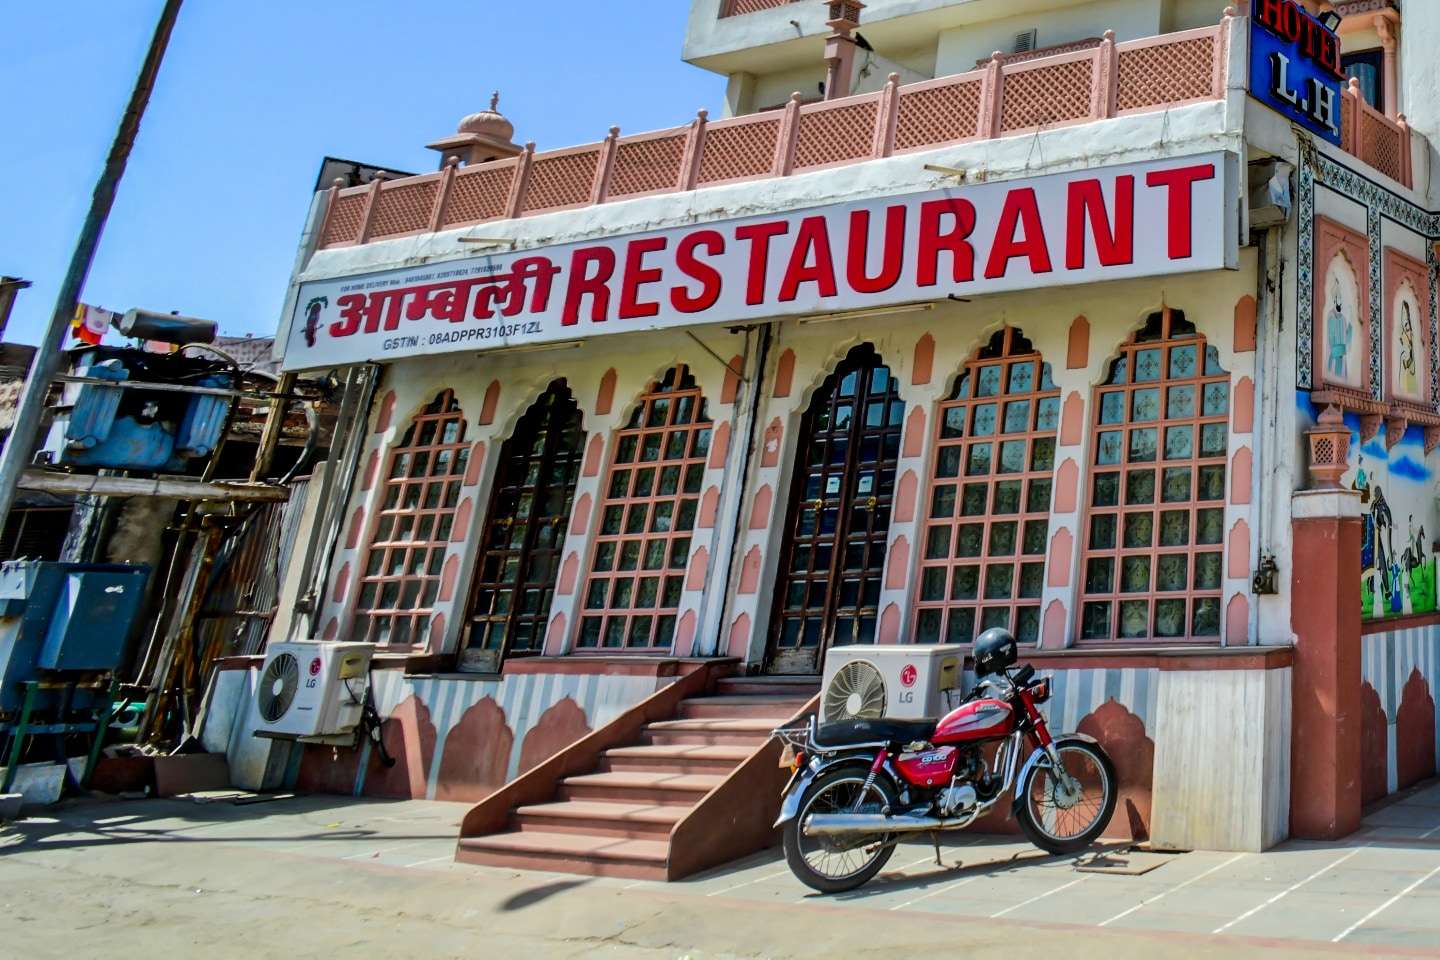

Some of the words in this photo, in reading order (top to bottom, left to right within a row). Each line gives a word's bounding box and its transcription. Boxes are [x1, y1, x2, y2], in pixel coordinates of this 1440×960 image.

[561, 163, 1215, 327] RESTAURANT
[383, 335, 419, 351] GSTIN
[306, 679, 316, 688] LG
[899, 691, 913, 703] LG
